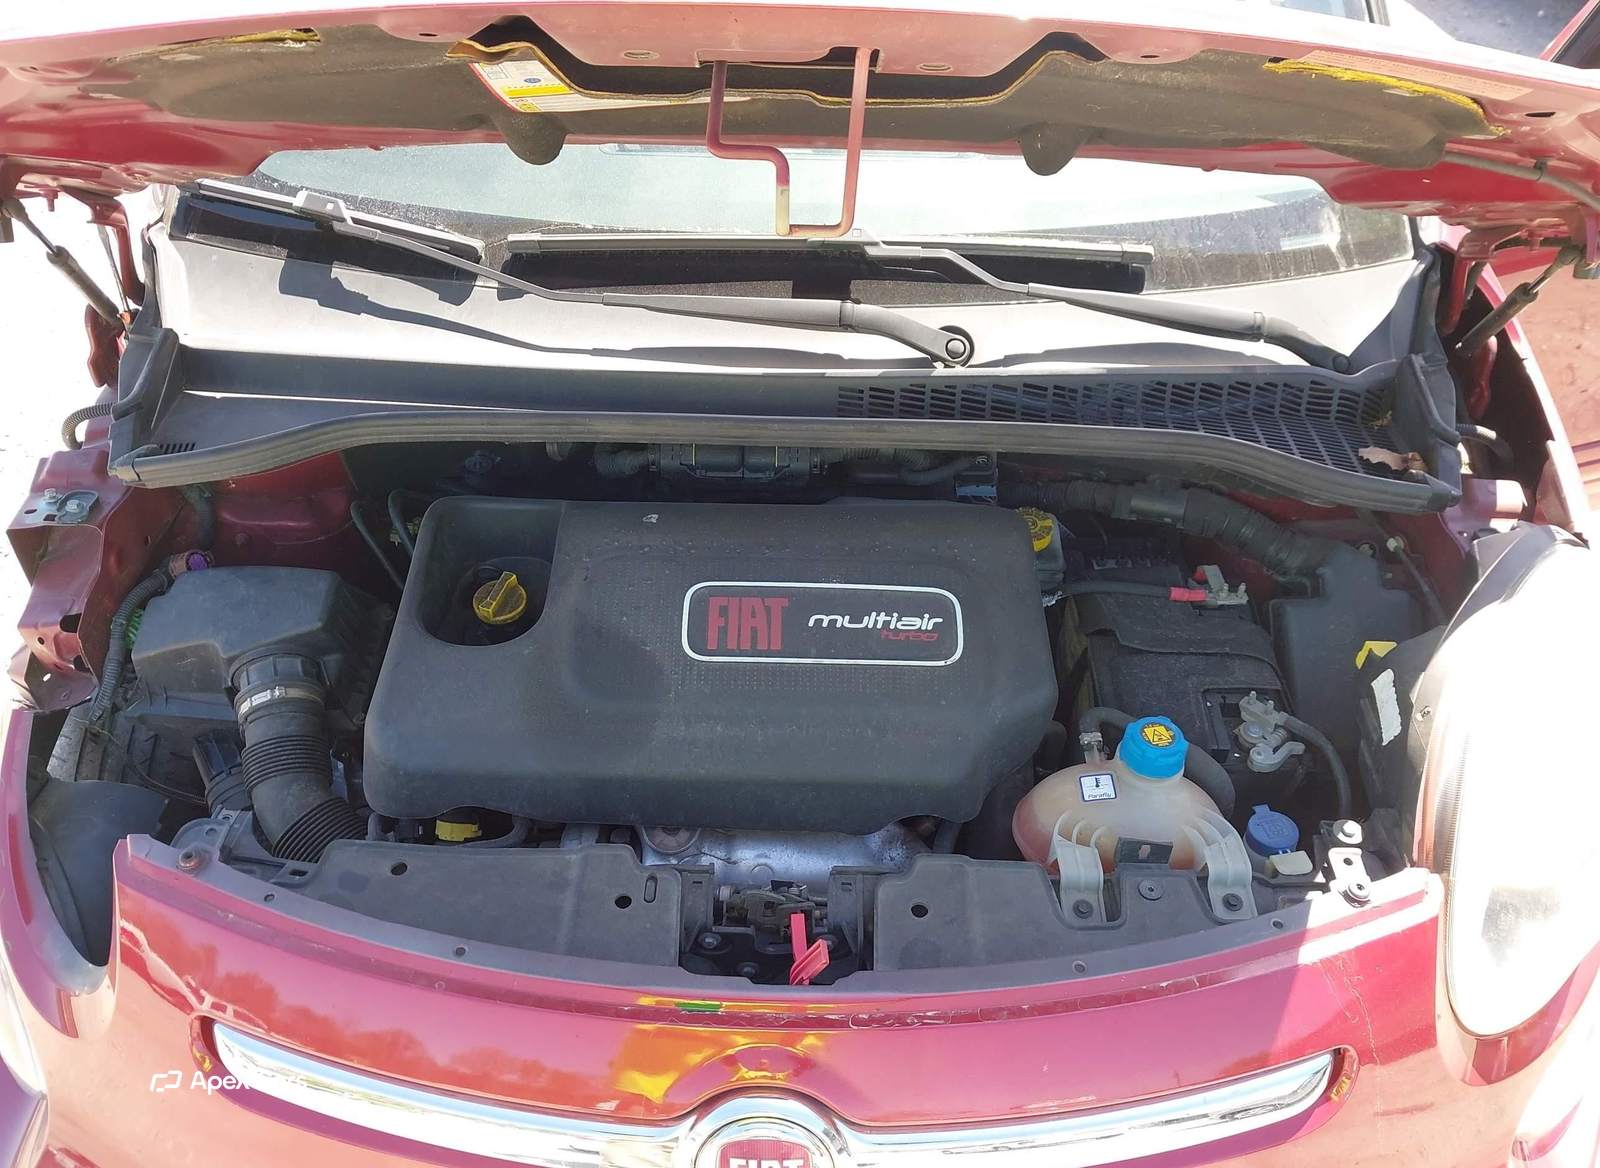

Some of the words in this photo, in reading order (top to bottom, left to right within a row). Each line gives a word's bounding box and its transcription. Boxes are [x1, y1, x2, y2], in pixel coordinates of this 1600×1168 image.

[707, 597, 788, 650] FIAT
[808, 612, 943, 630] multiair
[881, 629, 938, 641] turbo
